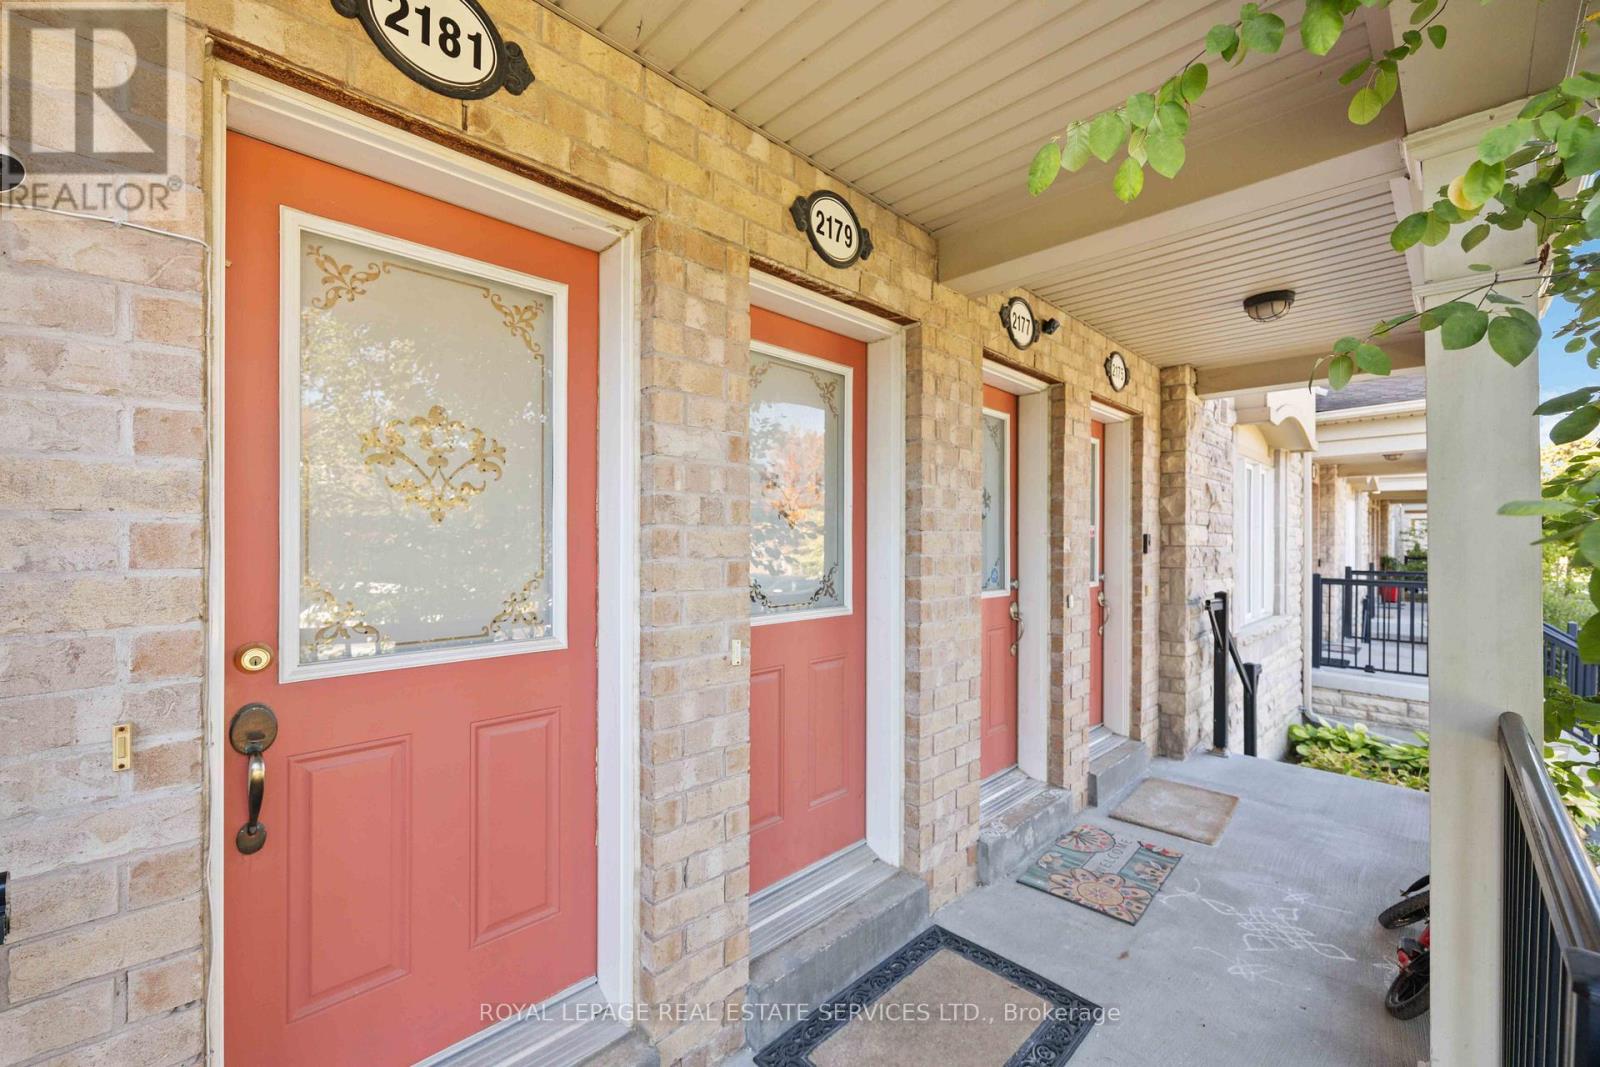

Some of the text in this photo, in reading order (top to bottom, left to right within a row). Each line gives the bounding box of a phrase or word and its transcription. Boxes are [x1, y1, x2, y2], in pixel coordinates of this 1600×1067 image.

[384, 0, 482, 71] 2181
[816, 210, 853, 248] 2179
[1012, 312, 1030, 335] 2177
